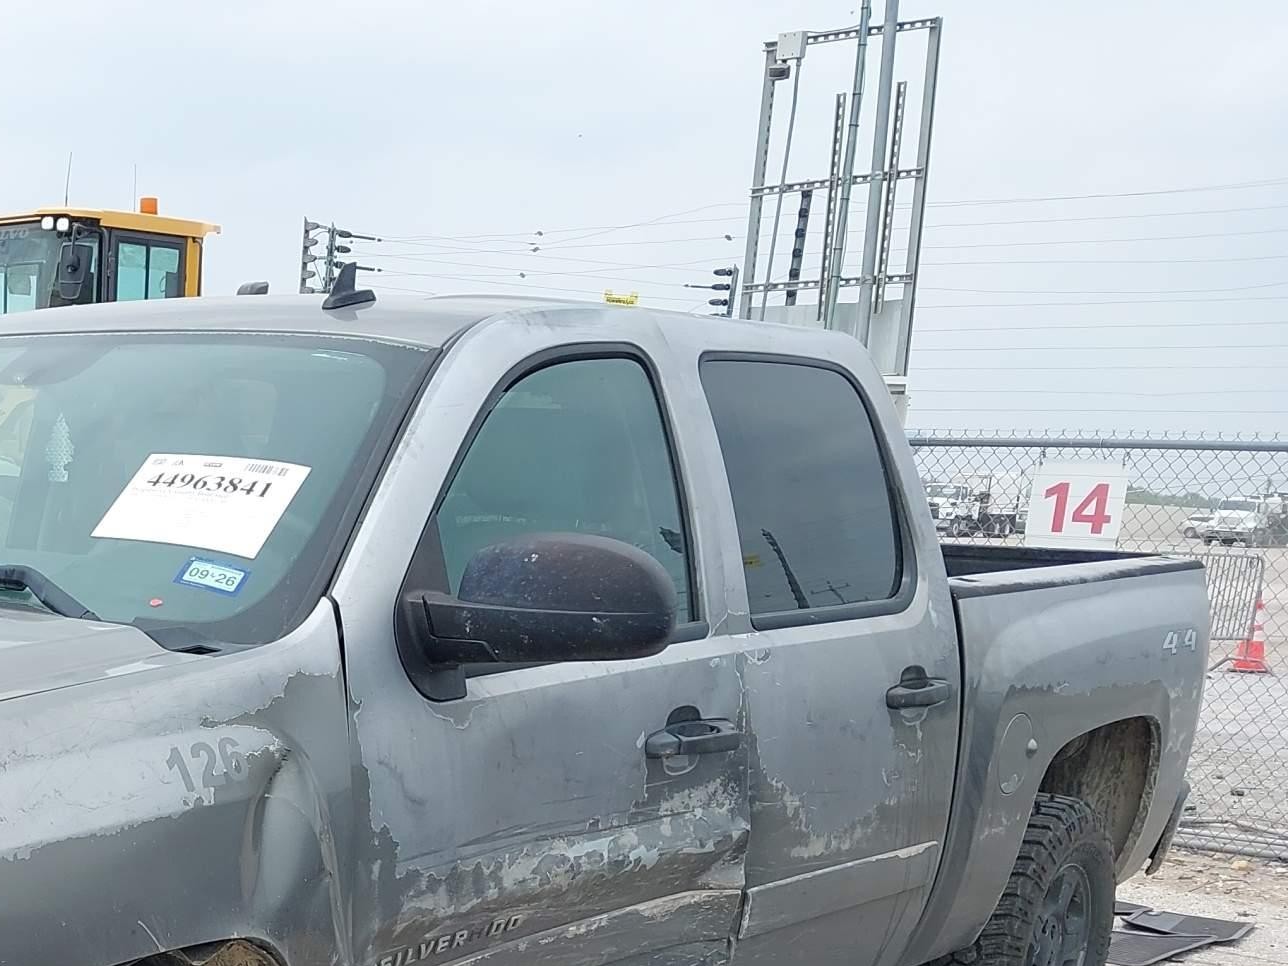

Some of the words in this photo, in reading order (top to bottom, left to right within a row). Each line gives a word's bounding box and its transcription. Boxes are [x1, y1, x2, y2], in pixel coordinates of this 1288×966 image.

[146, 472, 273, 498] 44963841
[1044, 482, 1112, 535] 14
[166, 736, 249, 793] 126
